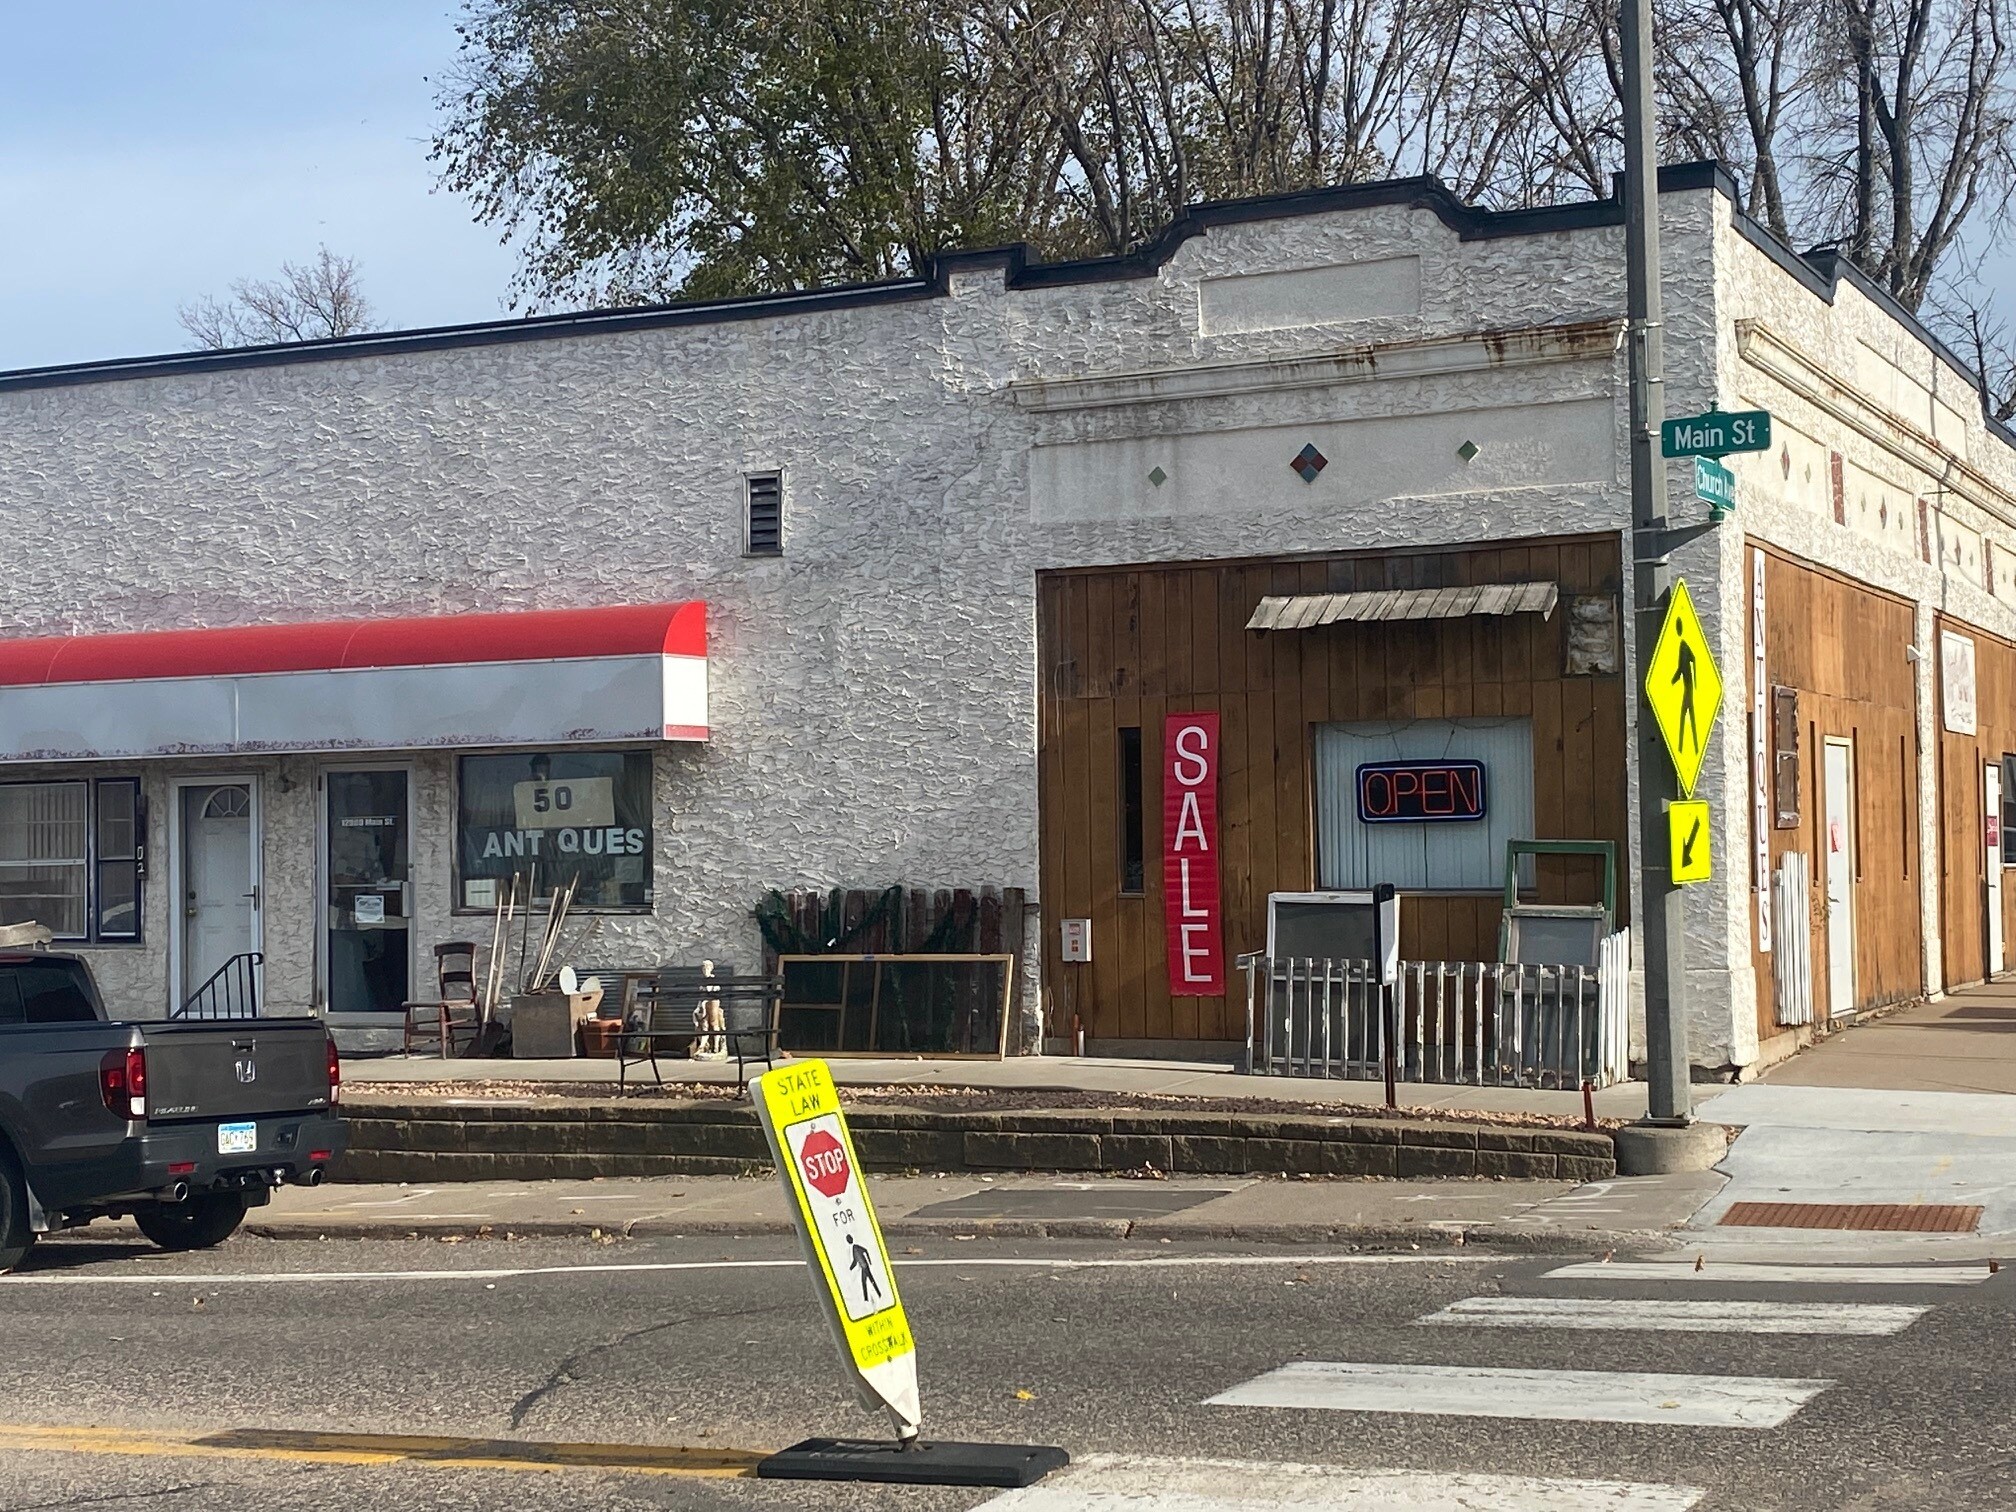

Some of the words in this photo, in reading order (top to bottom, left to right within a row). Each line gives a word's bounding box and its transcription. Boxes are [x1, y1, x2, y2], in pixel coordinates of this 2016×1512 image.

[1674, 423, 1724, 451] Main
[1731, 419, 1756, 445] St
[1697, 464, 1723, 496] Church
[1755, 560, 1768, 941] ANTIQUES
[532, 785, 574, 813] 50
[1365, 769, 1478, 816] OPEN
[1173, 725, 1213, 982] SALE
[777, 1069, 822, 1096] STATE
[790, 1094, 821, 1117] LAW
[804, 1147, 844, 1182] STOP
[832, 1208, 856, 1228] FOR
[865, 1316, 895, 1337] WITHIN
[860, 1332, 908, 1362] CROSSWALK
